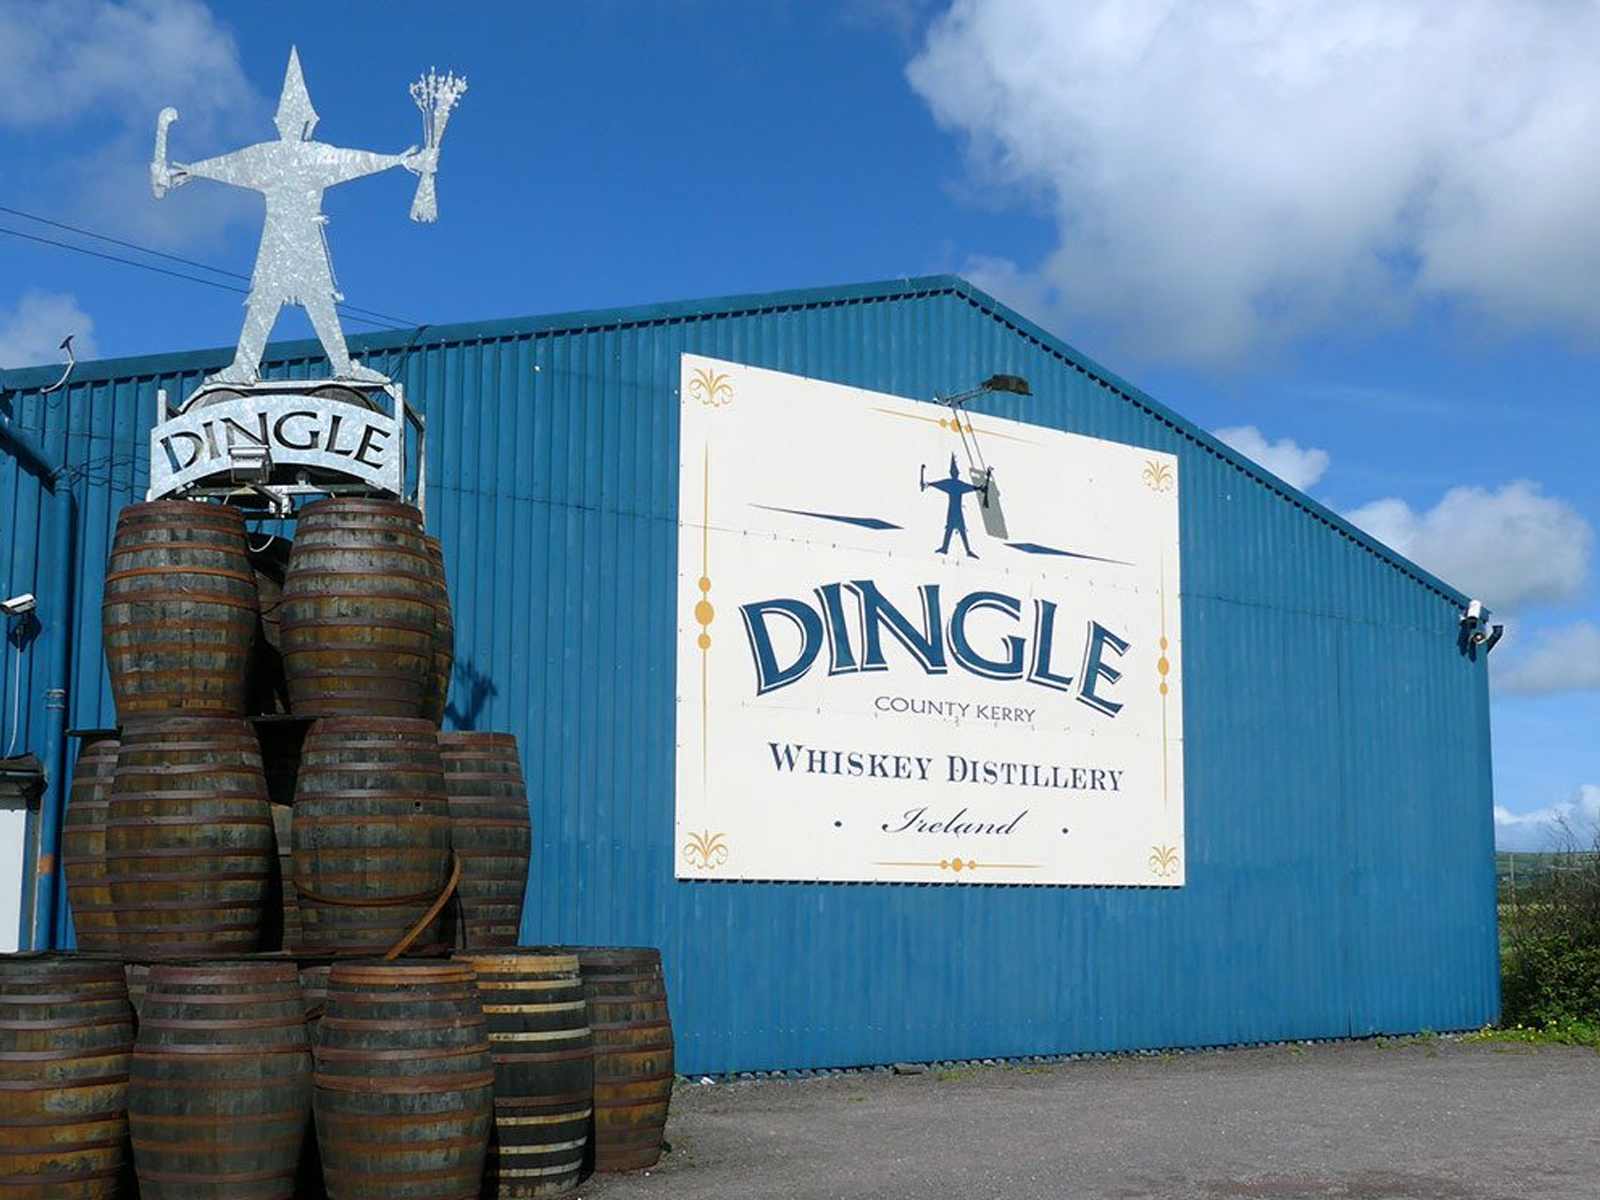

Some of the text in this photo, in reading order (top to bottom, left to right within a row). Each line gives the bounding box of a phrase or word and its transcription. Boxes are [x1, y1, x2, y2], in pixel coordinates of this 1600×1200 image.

[160, 411, 391, 475] DINGLE
[739, 579, 1132, 719] DINGLE
[874, 695, 1036, 723] COUNTY KERRY
[768, 742, 1124, 792] WHISKEY DISTILLERY
[881, 807, 1028, 836] Ireland
